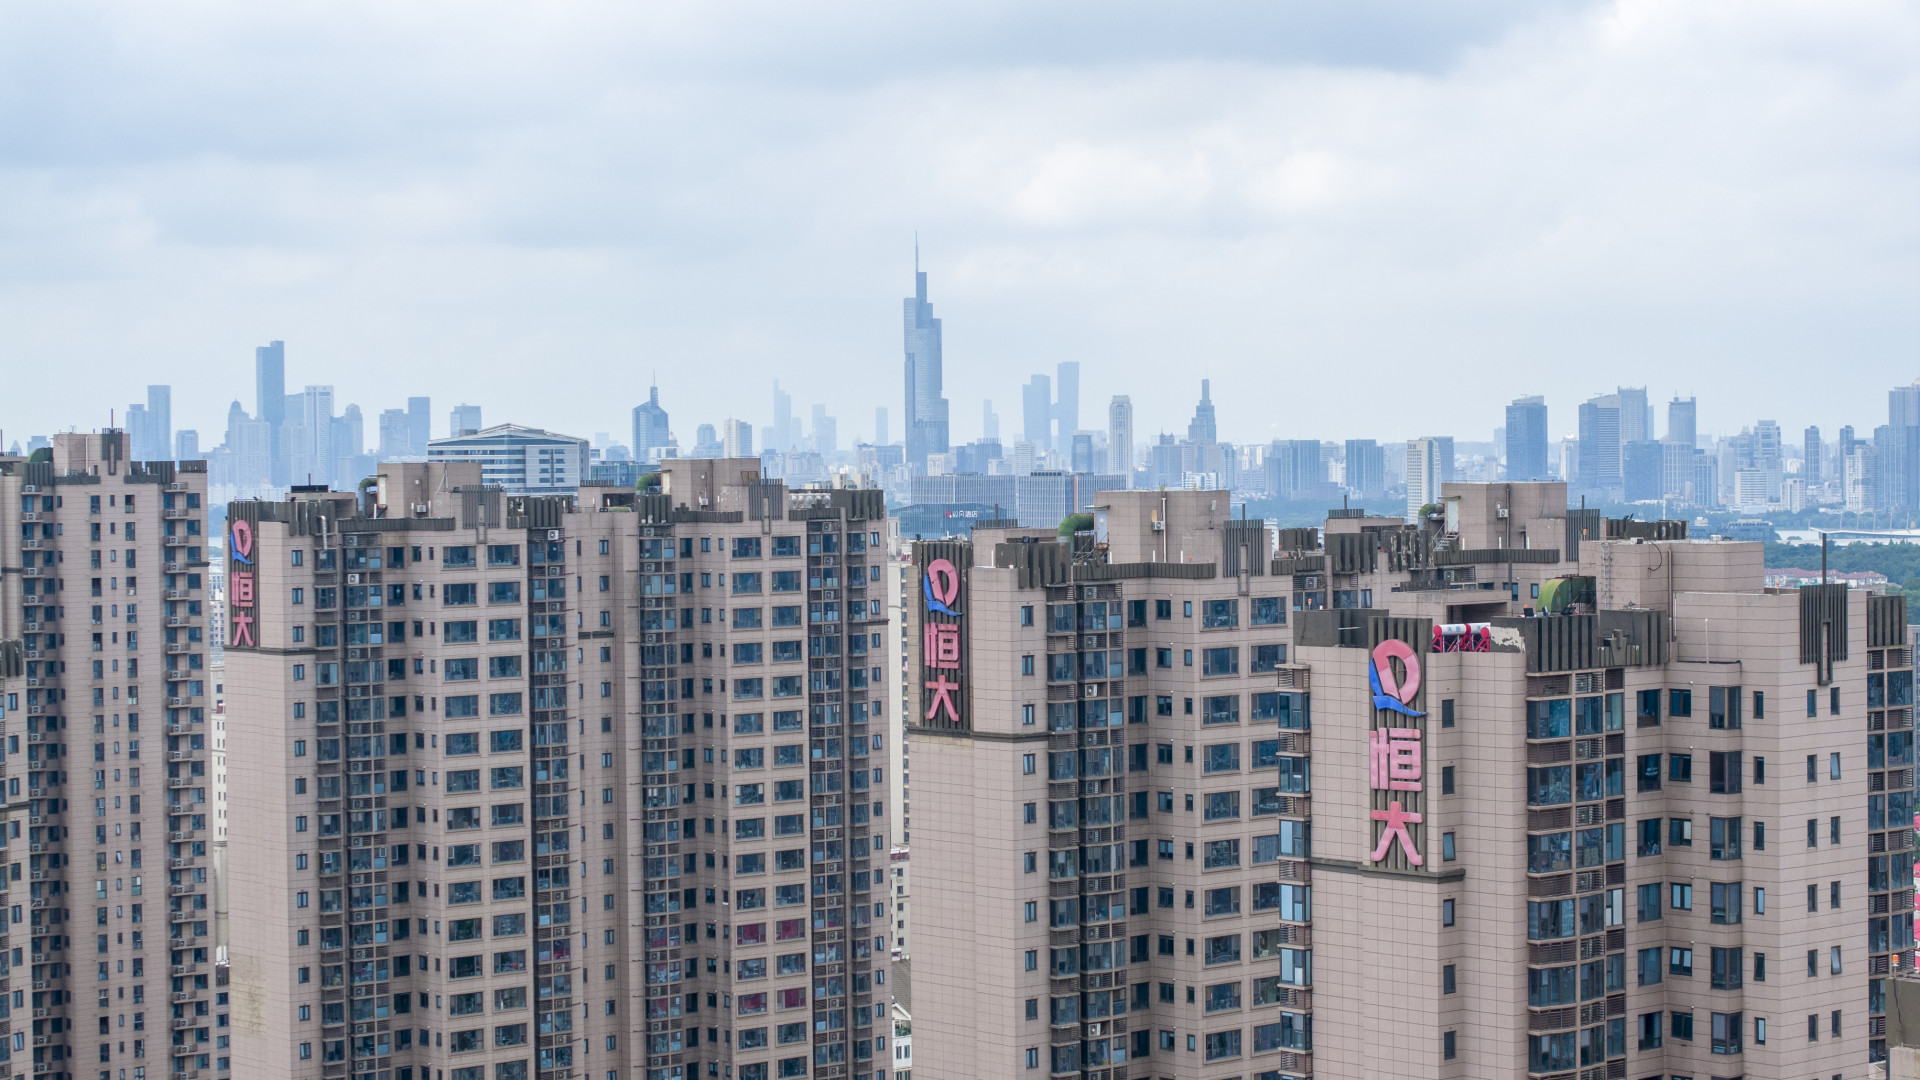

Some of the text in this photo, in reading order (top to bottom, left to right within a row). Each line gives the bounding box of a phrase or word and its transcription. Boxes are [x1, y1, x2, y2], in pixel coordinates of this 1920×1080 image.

[231, 571, 254, 646] 恒大
[923, 622, 960, 722] 恒大
[1370, 727, 1423, 866] 恒大
